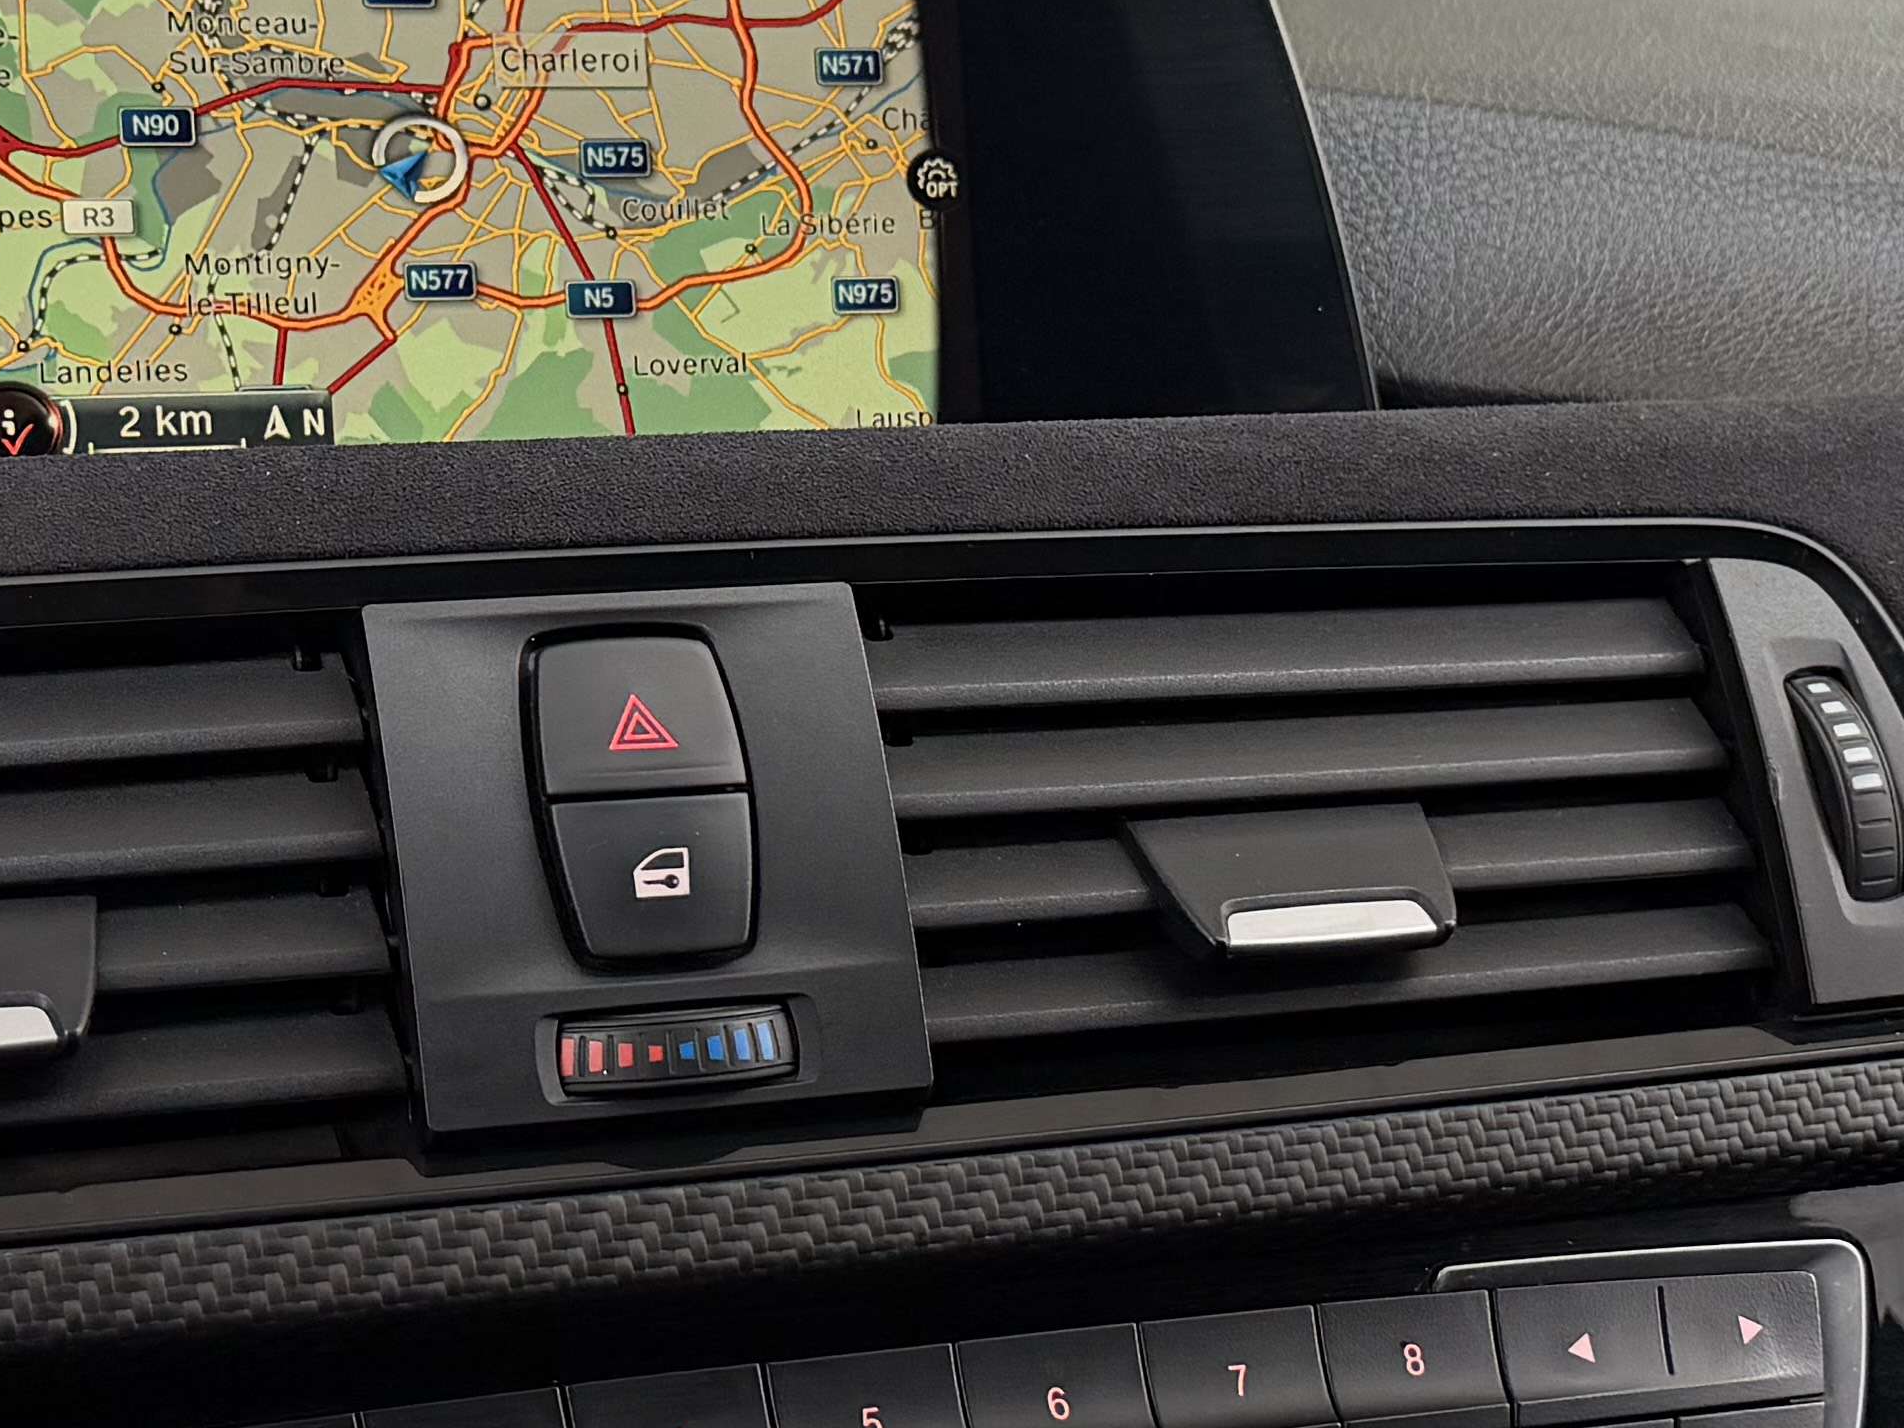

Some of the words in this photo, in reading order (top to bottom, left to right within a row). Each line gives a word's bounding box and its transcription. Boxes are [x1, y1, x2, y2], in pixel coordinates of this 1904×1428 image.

[168, 12, 318, 35] Monceau-
[170, 51, 345, 74] Sur-Sambre
[501, 47, 640, 73] Charleroi
[822, 56, 876, 76] N571
[132, 113, 180, 135] N90
[586, 146, 644, 169] N575
[926, 181, 958, 198] OPT
[83, 207, 115, 227] R3
[622, 197, 729, 222] Couillet
[760, 214, 791, 237] La
[800, 211, 896, 236] Sibérie
[185, 252, 341, 279] Montigny-
[410, 269, 468, 290] N577
[188, 292, 318, 317] le-Tilleul
[583, 287, 615, 309] N5
[839, 286, 894, 305] N975
[40, 361, 188, 384] Landelies
[633, 353, 748, 377] Loverval
[119, 410, 142, 438] 2
[157, 405, 213, 437] km
[303, 408, 325, 437] N
[1402, 1342, 1426, 1377] 8
[1227, 1363, 1249, 1398] 7
[1044, 1386, 1071, 1422] 6
